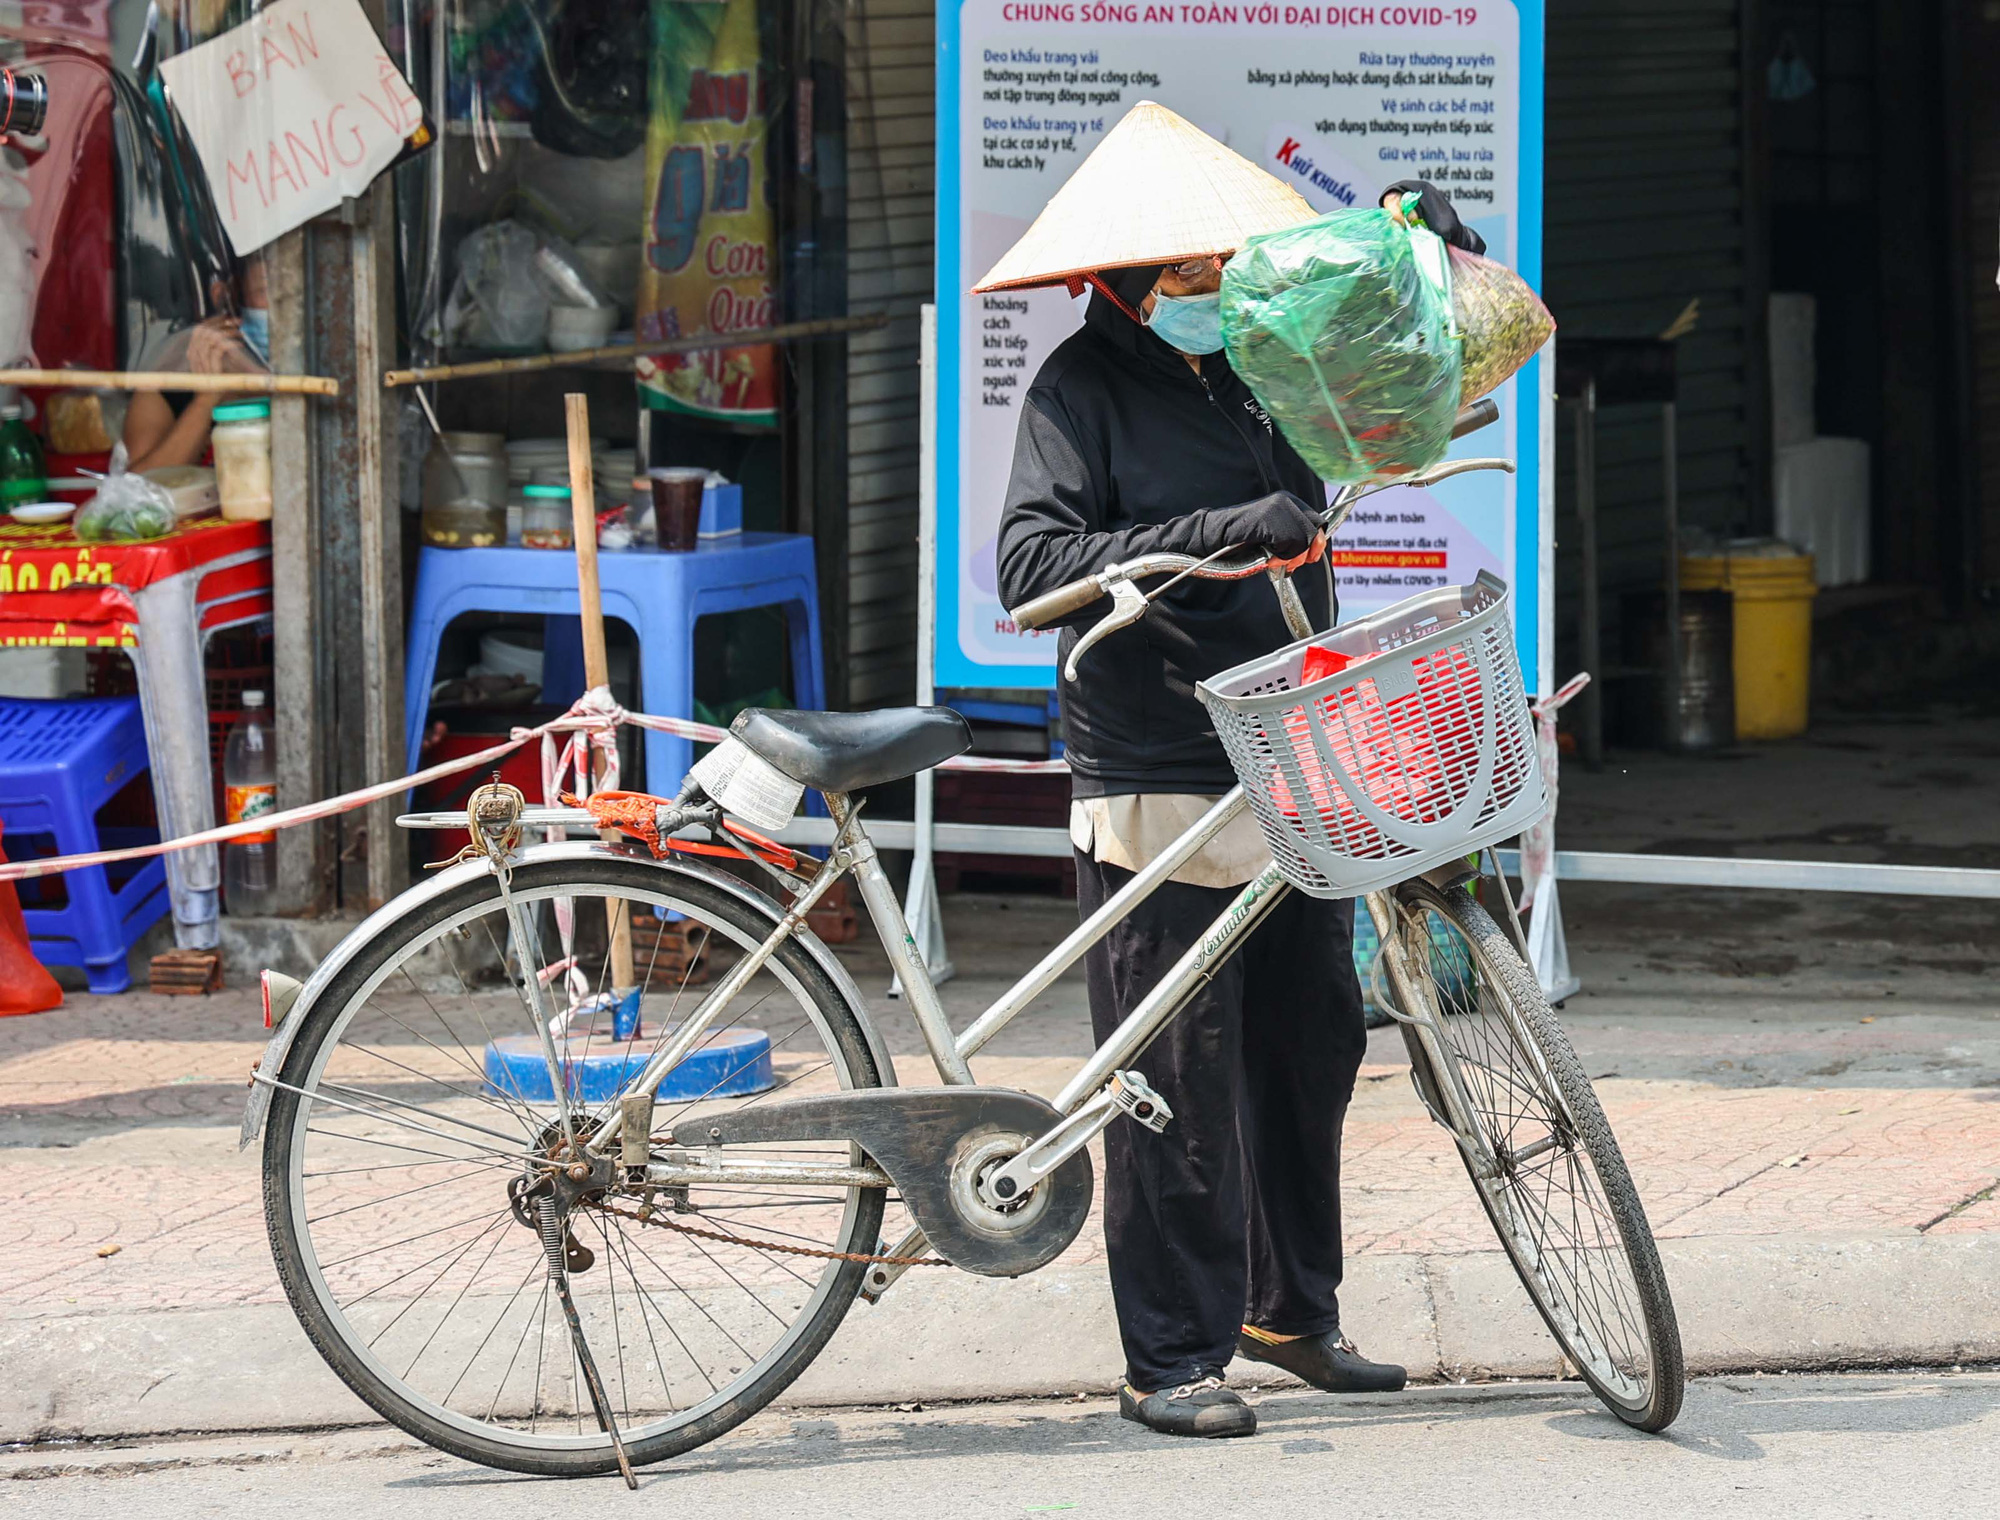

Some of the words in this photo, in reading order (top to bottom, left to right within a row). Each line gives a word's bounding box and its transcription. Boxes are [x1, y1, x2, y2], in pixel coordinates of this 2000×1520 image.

[1003, 4, 1075, 22] CHUNG
[1081, 0, 1137, 22] SỐNG
[1144, 5, 1173, 22] AN
[1181, 1, 1237, 23] TOÀN
[1244, 2, 1278, 24] VỚI
[1285, 7, 1320, 28] ĐẠI
[1327, 7, 1374, 28] DỊCH
[1380, 7, 1477, 25] COVID-19
[983, 49, 1007, 63] Đeo
[1010, 47, 1040, 63] khẩu
[1045, 53, 1077, 66] trang
[1080, 50, 1098, 64] vải
[1359, 52, 1383, 65] Rửa
[1386, 55, 1406, 67] tay
[1409, 53, 1453, 67] thường
[1456, 54, 1495, 68] xuyên
[983, 70, 1023, 85] thường
[1026, 71, 1061, 86] xuyên
[1064, 71, 1078, 84] tại
[1081, 72, 1098, 83] nơi
[1101, 73, 1128, 86] công
[1131, 73, 1160, 86] cộng,
[1248, 70, 1276, 84] bằng
[1279, 71, 1291, 84] xà
[1294, 71, 1329, 87] phòng
[1332, 71, 1358, 87] hoặc
[1361, 72, 1390, 88] dung
[1393, 72, 1416, 87] dịch
[1419, 72, 1435, 85] sát
[1438, 70, 1473, 85] khuẩn
[1475, 74, 1494, 88] tay
[983, 90, 1000, 100] nơi
[1004, 90, 1022, 103] tập
[1025, 91, 1054, 104] trung
[1057, 90, 1086, 104] đông
[1089, 90, 1120, 104] người
[1381, 99, 1397, 113] Vệ
[1401, 99, 1425, 112] sinh
[1429, 101, 1448, 112] các
[1452, 98, 1467, 112] bề
[1470, 101, 1494, 114] mặt
[983, 117, 1007, 130] Đeo
[1010, 115, 1040, 130] khẩu
[1044, 120, 1077, 134] trang
[1080, 121, 1087, 133] y
[1090, 118, 1103, 131] tế
[1338, 119, 1367, 135] dụng
[1369, 120, 1410, 136] thường
[1412, 122, 1447, 136] xuyên
[1450, 119, 1471, 136] tiếp
[1474, 121, 1494, 133] xúc
[983, 137, 997, 150] tại
[1001, 138, 1018, 149] các
[1021, 139, 1034, 150] cơ
[1037, 138, 1049, 150] sở
[1052, 140, 1059, 152] y
[1062, 136, 1076, 151] tế,
[226, 103, 366, 221] MANG
[983, 155, 1004, 168] khu
[1007, 155, 1032, 169] cách
[1035, 156, 1045, 170] ly
[1379, 148, 1399, 161] Giữ
[1402, 149, 1416, 162] vệ
[1420, 148, 1449, 162] sinh,
[1452, 149, 1471, 161] lau
[1473, 149, 1494, 162] rửa
[1418, 168, 1432, 180] và
[1434, 166, 1448, 180] để
[1451, 168, 1471, 180] nhà
[1474, 169, 1494, 181] cửa
[1309, 170, 1357, 206] KHUẨN
[1454, 188, 1494, 204] thoáng
[983, 297, 1028, 314] khoảng
[983, 317, 1010, 329] cách
[983, 335, 1001, 348] khi
[1005, 335, 1028, 351] tiếp
[983, 356, 1003, 367] xúc
[1007, 355, 1025, 367] với
[983, 374, 1017, 389] người
[983, 393, 1010, 406] khác
[1355, 511, 1382, 524] bệnh
[1385, 514, 1397, 523] an
[1400, 512, 1424, 523] toàn
[1357, 538, 1400, 547] Bluezone
[1403, 538, 1414, 548] tại
[1417, 538, 1431, 548] địa
[1434, 538, 1447, 548] chỉ
[1343, 576, 1353, 584] cơ
[1355, 575, 1370, 586] lây
[1372, 574, 1401, 584] nhiễm
[1404, 576, 1447, 585] COVID-19
